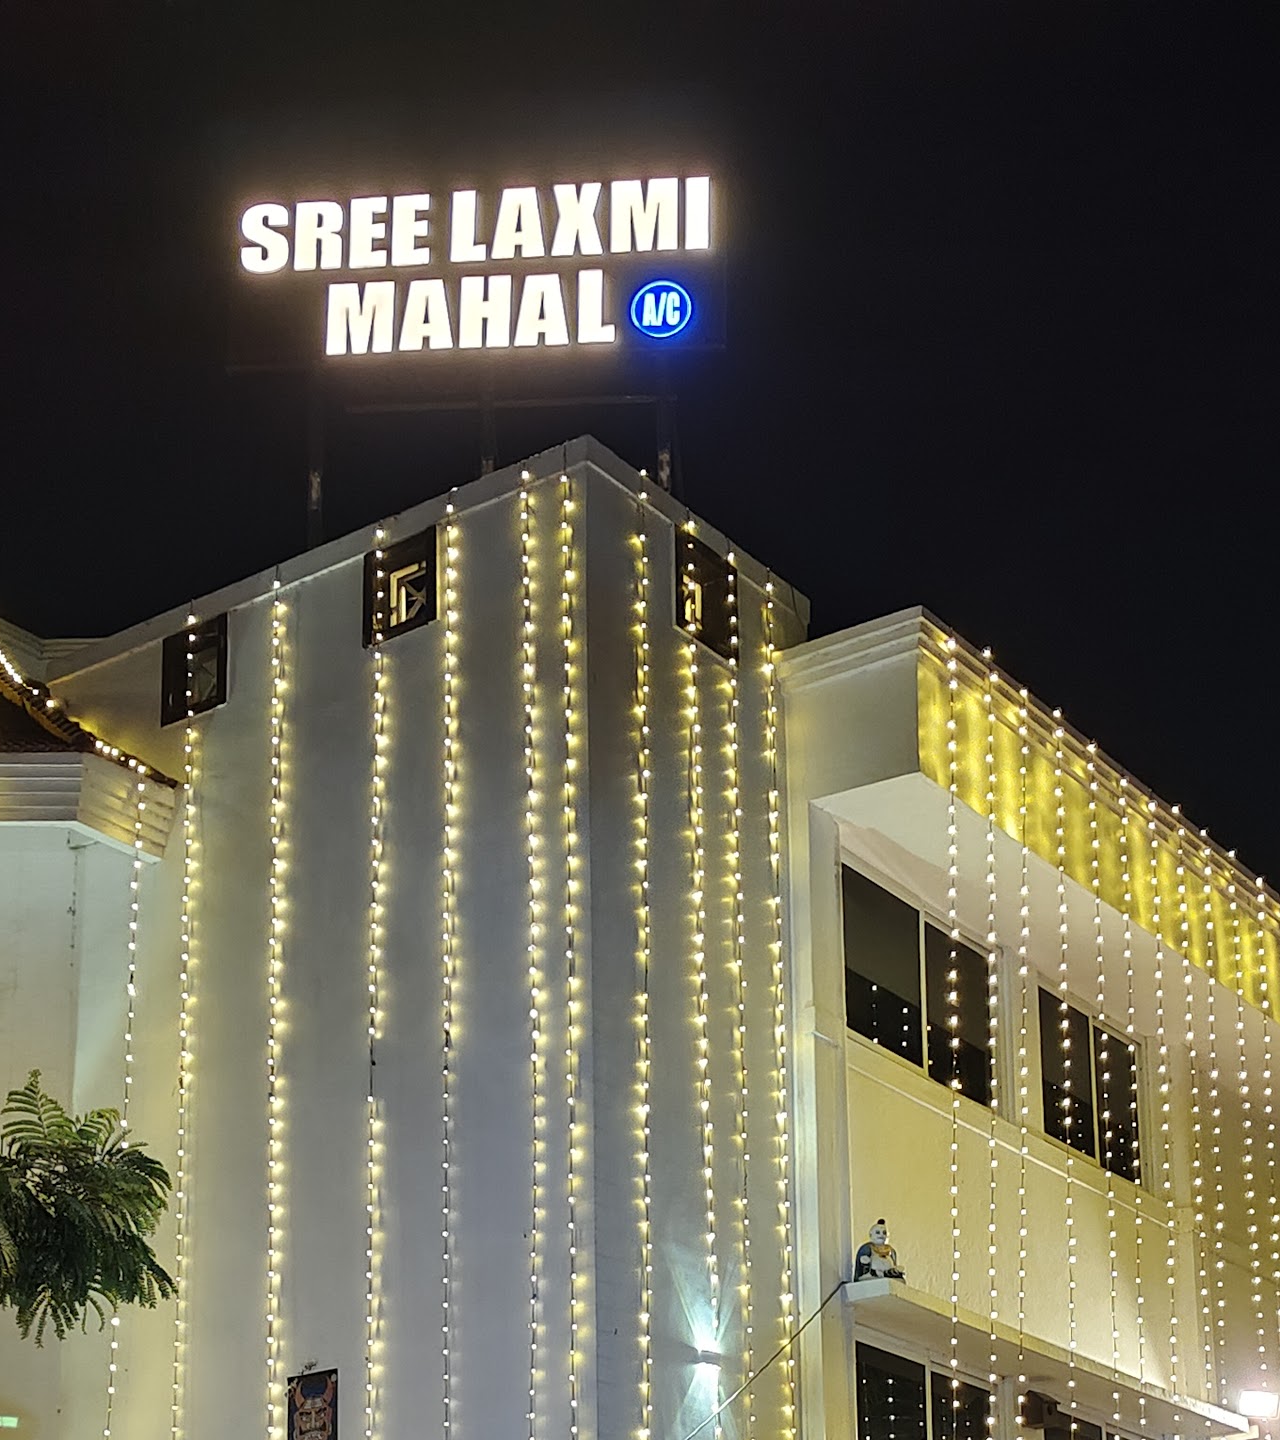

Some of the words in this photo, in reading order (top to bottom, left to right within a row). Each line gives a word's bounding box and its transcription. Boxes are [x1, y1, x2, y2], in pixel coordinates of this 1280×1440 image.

[239, 194, 431, 276] SREE
[449, 175, 712, 264] LAXMI
[324, 269, 617, 356] MAHAL
[642, 291, 681, 327] A/C
